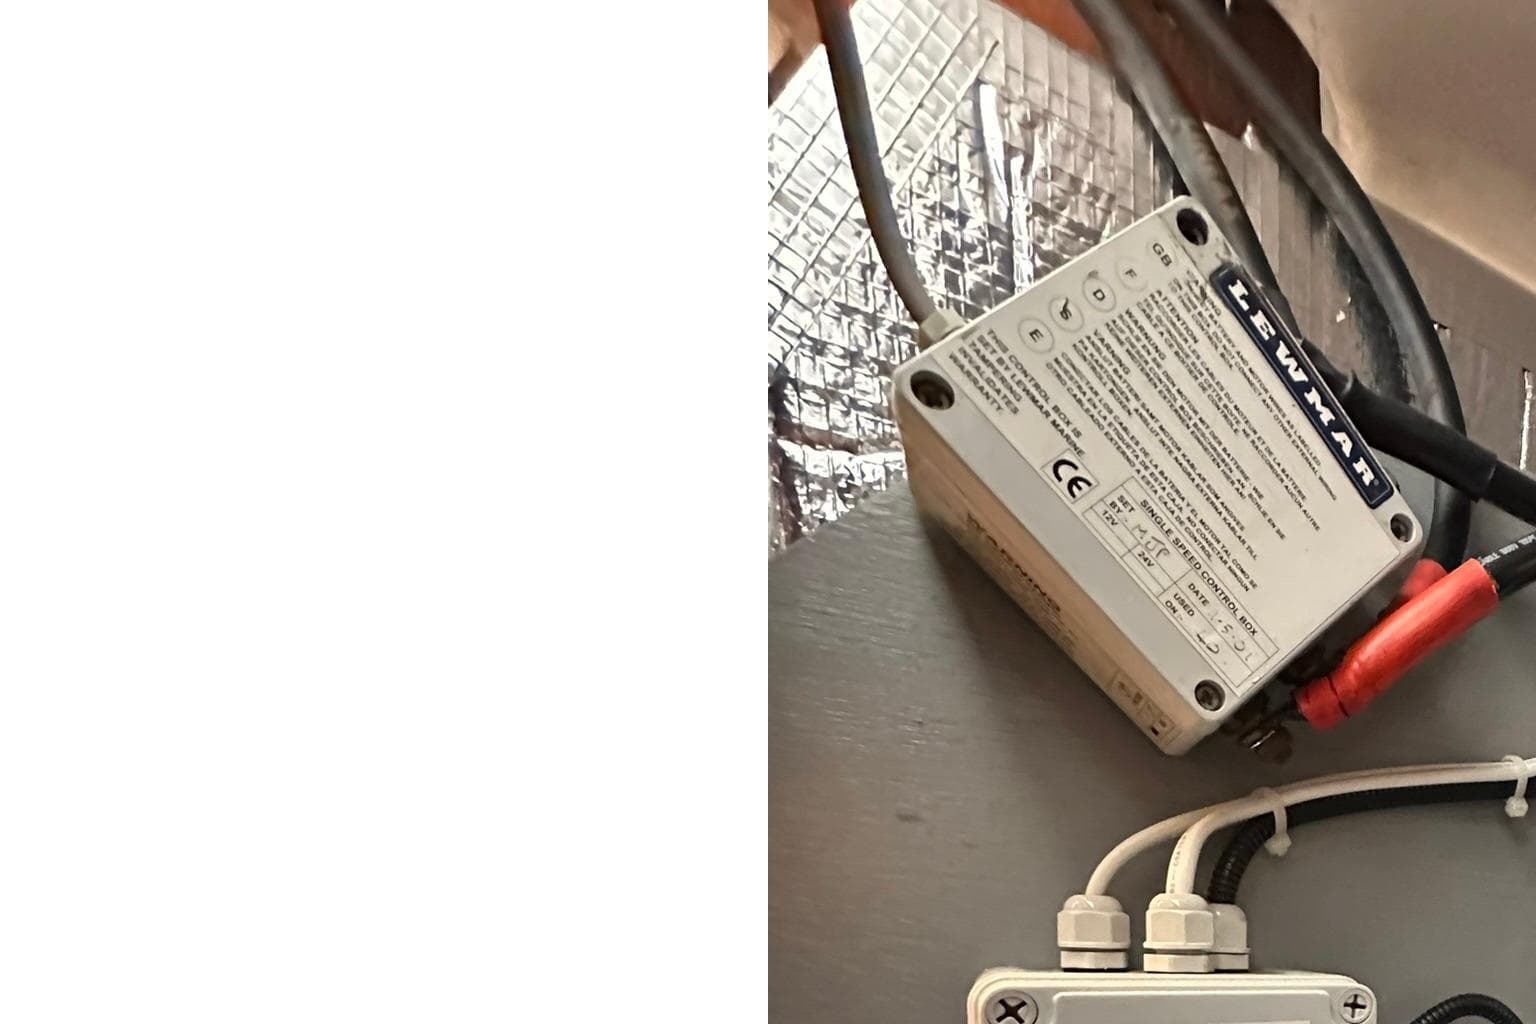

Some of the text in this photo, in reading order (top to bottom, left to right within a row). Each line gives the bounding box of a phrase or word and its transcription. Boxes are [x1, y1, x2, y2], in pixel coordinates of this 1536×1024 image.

[1149, 240, 1174, 268] GB
[1123, 267, 1138, 280] F
[1090, 287, 1107, 303] D
[1057, 306, 1074, 321] S
[1154, 287, 1199, 345] ATTENTION
[1026, 327, 1045, 343] E
[956, 344, 1021, 416] INVALIDATES
[966, 338, 1024, 404] TAMPERING
[975, 333, 998, 357] SET
[994, 355, 1012, 373] BY
[1008, 371, 1052, 420] LEWMAR
[1226, 278, 1377, 486] LEWMAR
[1234, 348, 1250, 367] AND
[1246, 366, 1270, 394] MOTOR
[1006, 352, 1052, 403] CONTROL
[1050, 403, 1073, 427] BOX
[1069, 426, 1083, 439] IS
[1174, 387, 1199, 417] MOTOR
[1260, 397, 1275, 414] ANY
[1157, 423, 1182, 453] MOTOR
[1046, 453, 1094, 499] CE
[1115, 493, 1136, 514] SET
[1099, 508, 1119, 528] 12V
[1197, 518, 1222, 545] MOTOR
[1136, 549, 1155, 569] 24V
[1138, 497, 1174, 538] SINGLE
[1170, 535, 1203, 571] SPEED
[1199, 569, 1241, 617] CONTROL
[1238, 614, 1258, 637] BOX
[1172, 591, 1196, 618] USED
[1186, 581, 1210, 607] DATE
